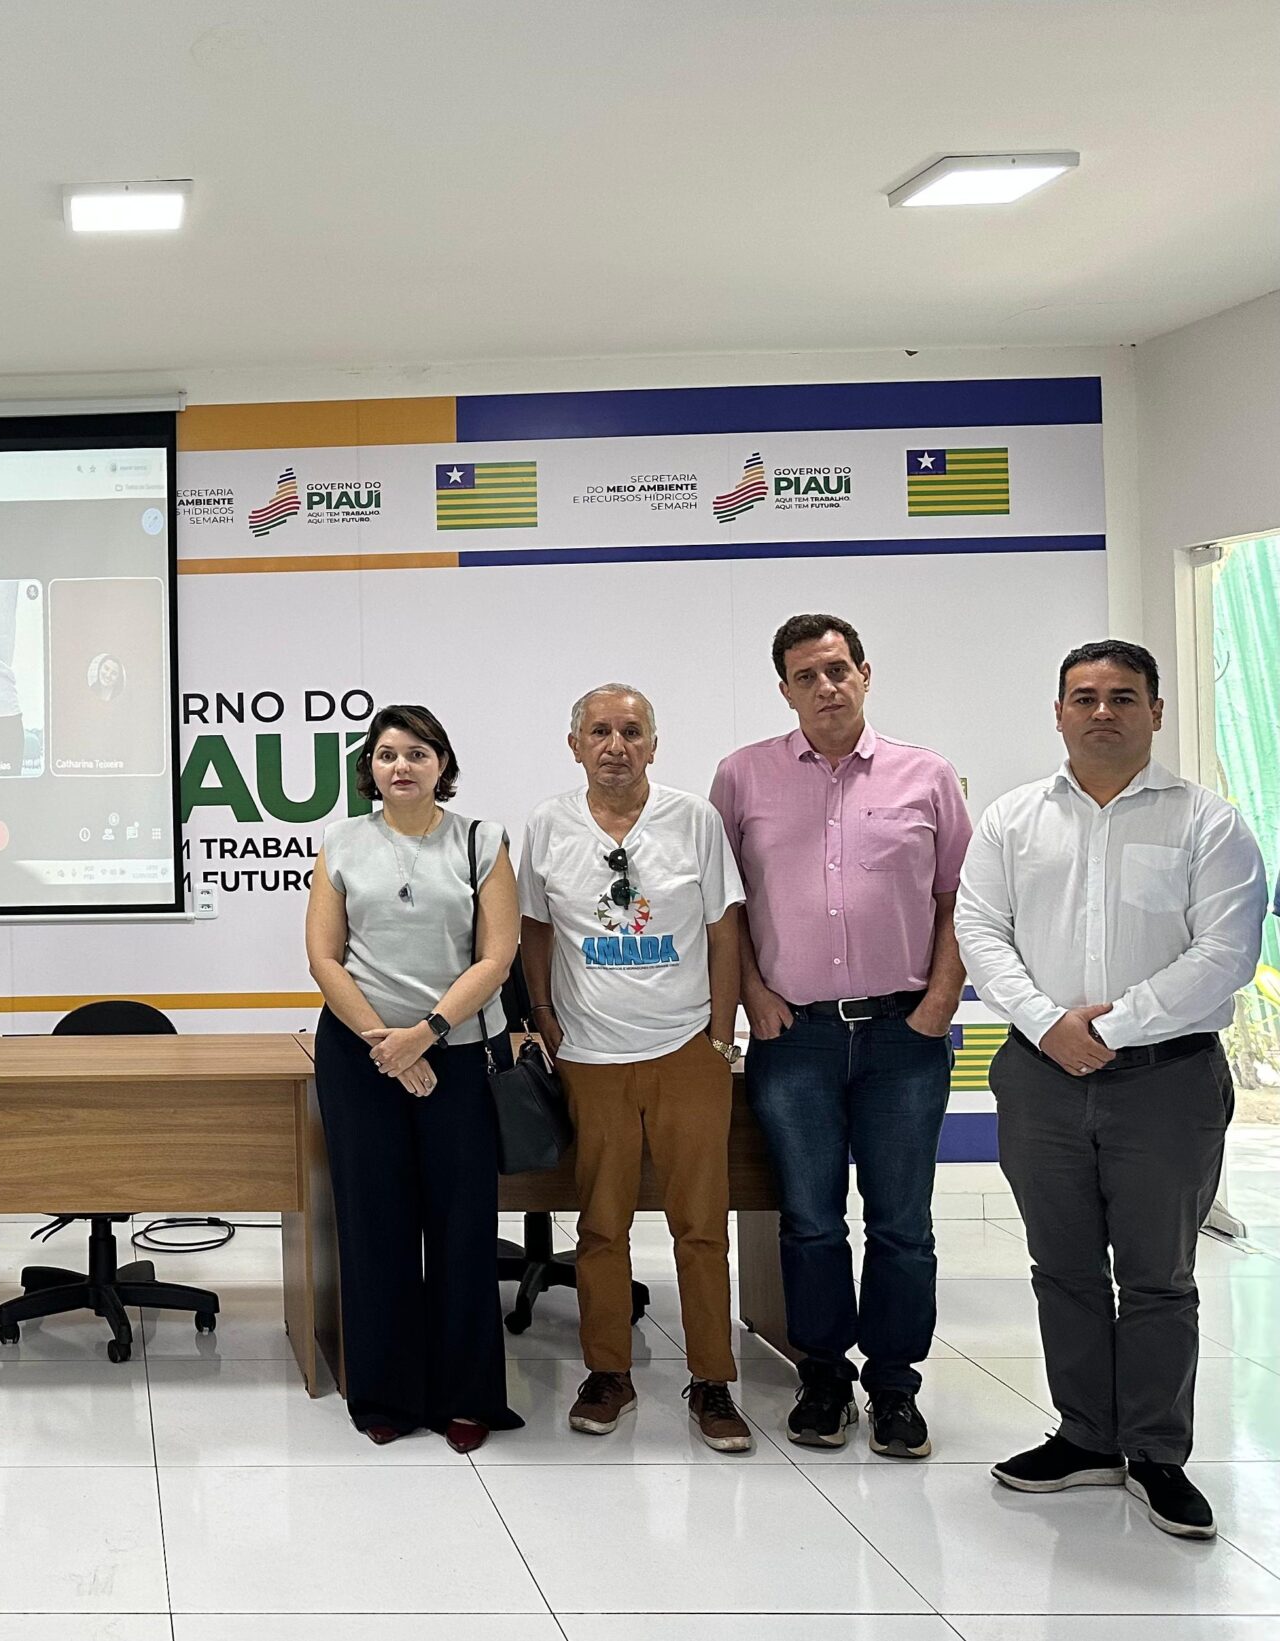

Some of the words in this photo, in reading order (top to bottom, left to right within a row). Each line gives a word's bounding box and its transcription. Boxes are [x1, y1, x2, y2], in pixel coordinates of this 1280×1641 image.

[774, 467, 831, 476] GOVERNO
[834, 466, 851, 475] DO
[630, 474, 697, 483] SECRETARIA
[306, 482, 361, 490] GOVERNO
[364, 481, 381, 489] DO
[587, 486, 604, 494] DO
[606, 484, 636, 493] MEIO
[639, 483, 697, 493] AMBIENTE
[774, 476, 851, 496] PIAUÍ
[176, 489, 234, 498] ECRETARIA
[573, 496, 580, 504] E
[582, 494, 642, 503] RECURSOS
[644, 491, 697, 501] HÍDRICOS
[177, 498, 234, 506] AMBIENTE
[306, 491, 381, 510] PIAUÍ
[182, 506, 234, 516] HÍDRICOS
[651, 502, 697, 511] SEMARH
[189, 516, 234, 525] SEMARH
[305, 689, 375, 722] DO
[56, 759, 94, 769] Catharina
[95, 759, 124, 769] Teixeira
[180, 732, 373, 823] AUÍ
[200, 837, 318, 859] TRABAL
[582, 934, 680, 966] AMADA
